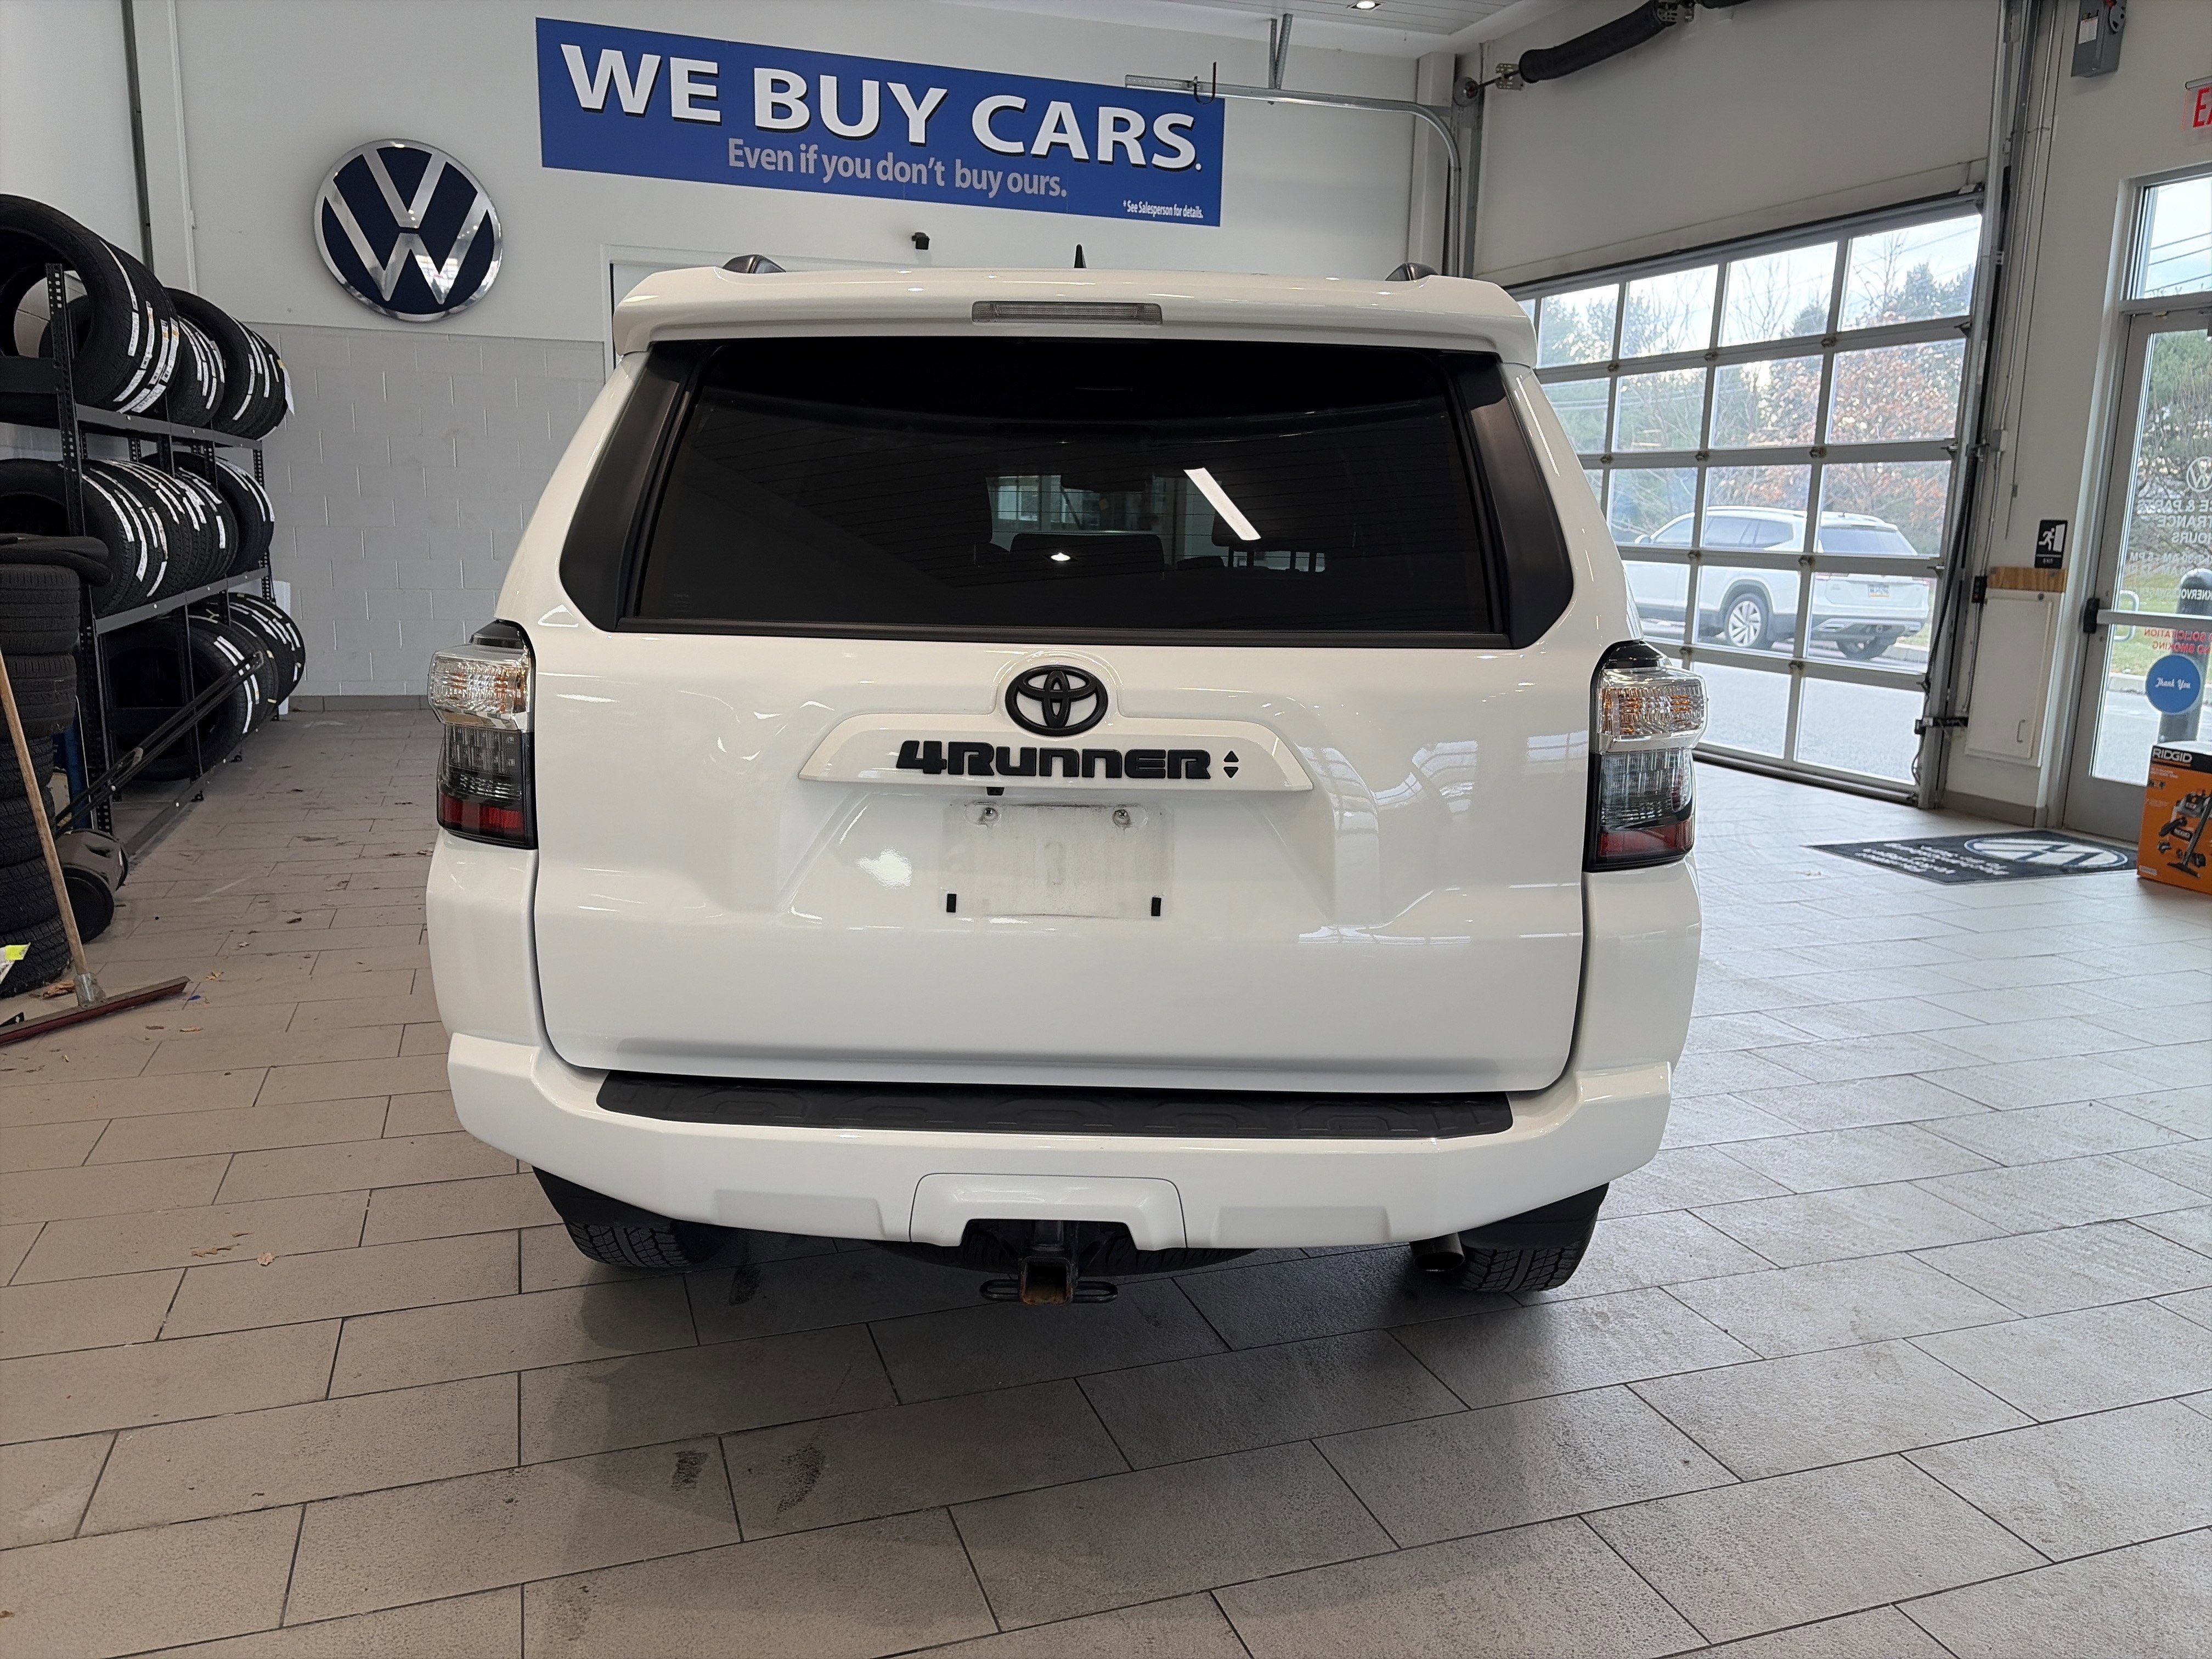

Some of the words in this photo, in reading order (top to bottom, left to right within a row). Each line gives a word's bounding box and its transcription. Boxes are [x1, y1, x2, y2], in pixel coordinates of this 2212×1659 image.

[560, 43, 721, 124] WE
[754, 67, 948, 145] BUY
[728, 138, 794, 172] Even
[800, 143, 819, 174] if
[821, 154, 871, 184] you
[876, 151, 945, 187] don't
[955, 159, 1003, 199] buy
[1006, 172, 1067, 198] ours.
[1138, 201, 1173, 217] Salesperson
[1173, 204, 1182, 216] for
[1183, 205, 1204, 218] details.
[2155, 677, 2175, 688] Thank
[2177, 679, 2191, 691] You
[2152, 748, 2193, 763] RIDGID
